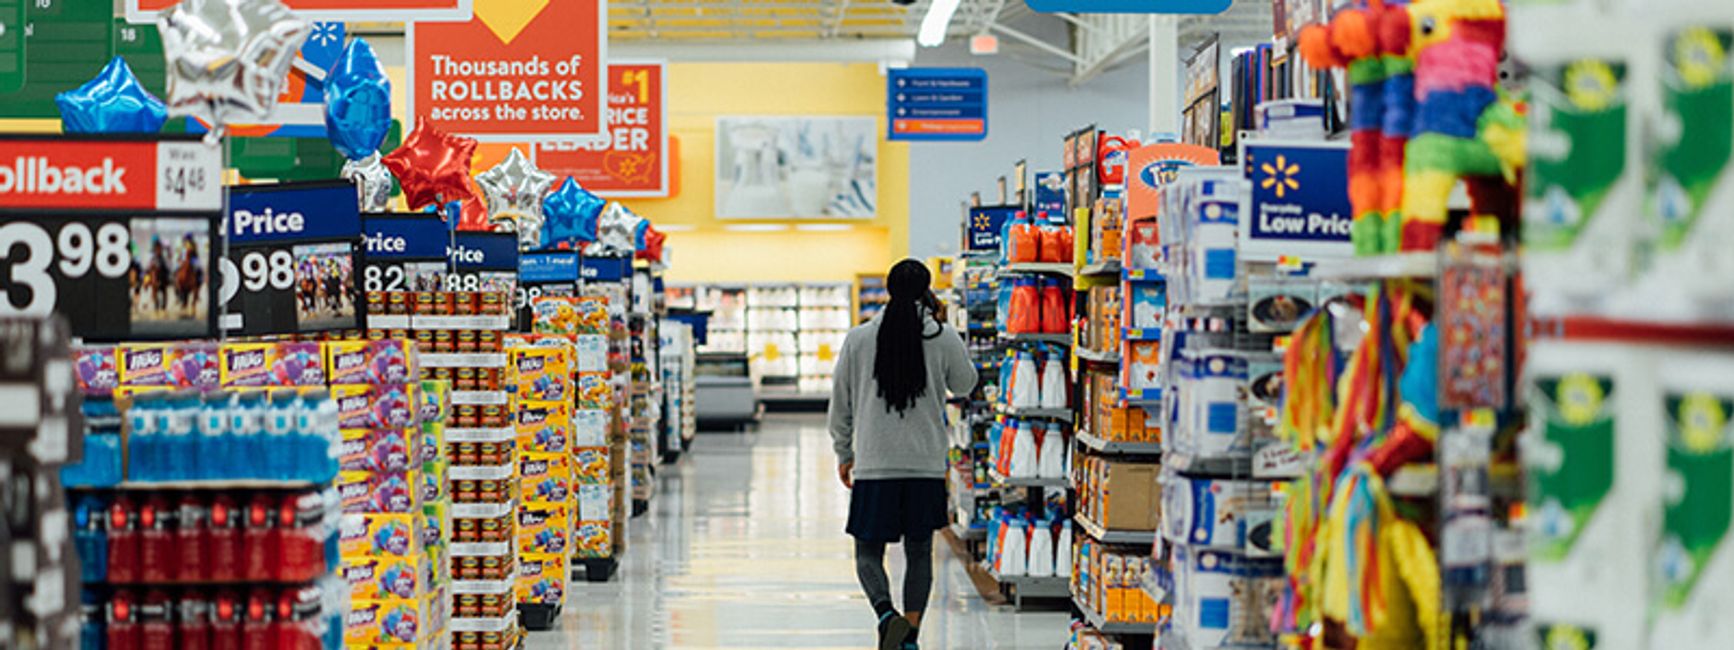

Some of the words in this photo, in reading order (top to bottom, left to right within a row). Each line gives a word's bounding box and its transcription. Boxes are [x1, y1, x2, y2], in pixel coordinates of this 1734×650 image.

[430, 55, 549, 76] Thousands
[555, 55, 581, 76] of
[431, 81, 583, 100] ROLLBACKS
[621, 70, 649, 105] #1
[431, 106, 490, 121] across
[496, 104, 526, 121] the
[532, 105, 585, 121] store.
[234, 207, 305, 235] Price
[1260, 213, 1305, 233] Low
[364, 265, 405, 292] 82
